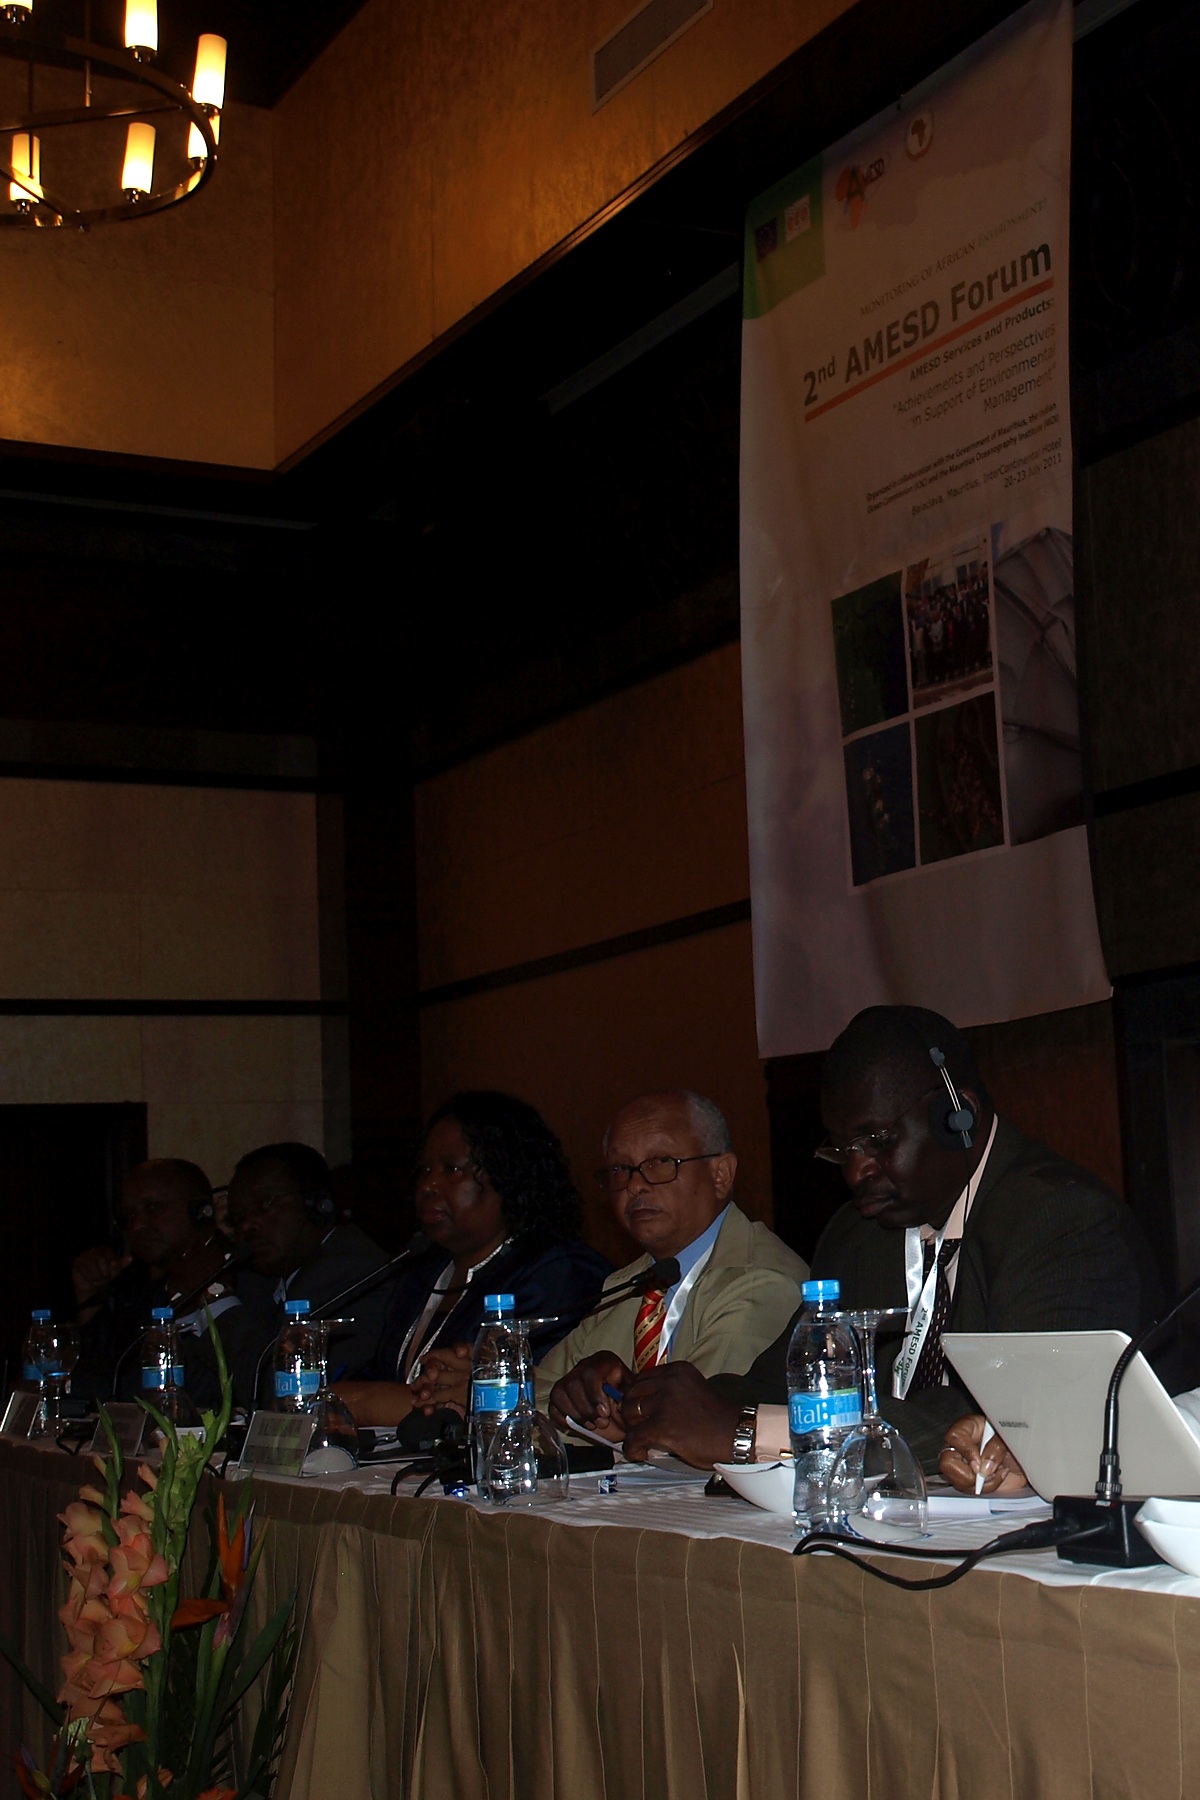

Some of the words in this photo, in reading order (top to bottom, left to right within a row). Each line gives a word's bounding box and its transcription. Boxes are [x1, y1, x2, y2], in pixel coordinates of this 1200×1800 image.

[803, 355, 836, 407] 2nd
[844, 299, 941, 383] AMESD
[951, 243, 1052, 321] Forum
[909, 356, 941, 383] AMESD
[943, 334, 982, 363] Services
[984, 322, 1003, 341] and
[966, 356, 986, 378] and
[988, 323, 1056, 367] Perspectives
[924, 392, 965, 422] Support
[965, 382, 977, 400] of
[979, 344, 1057, 393] Environmental
[906, 1321, 924, 1356] AMESD
[791, 1403, 822, 1425] ital
